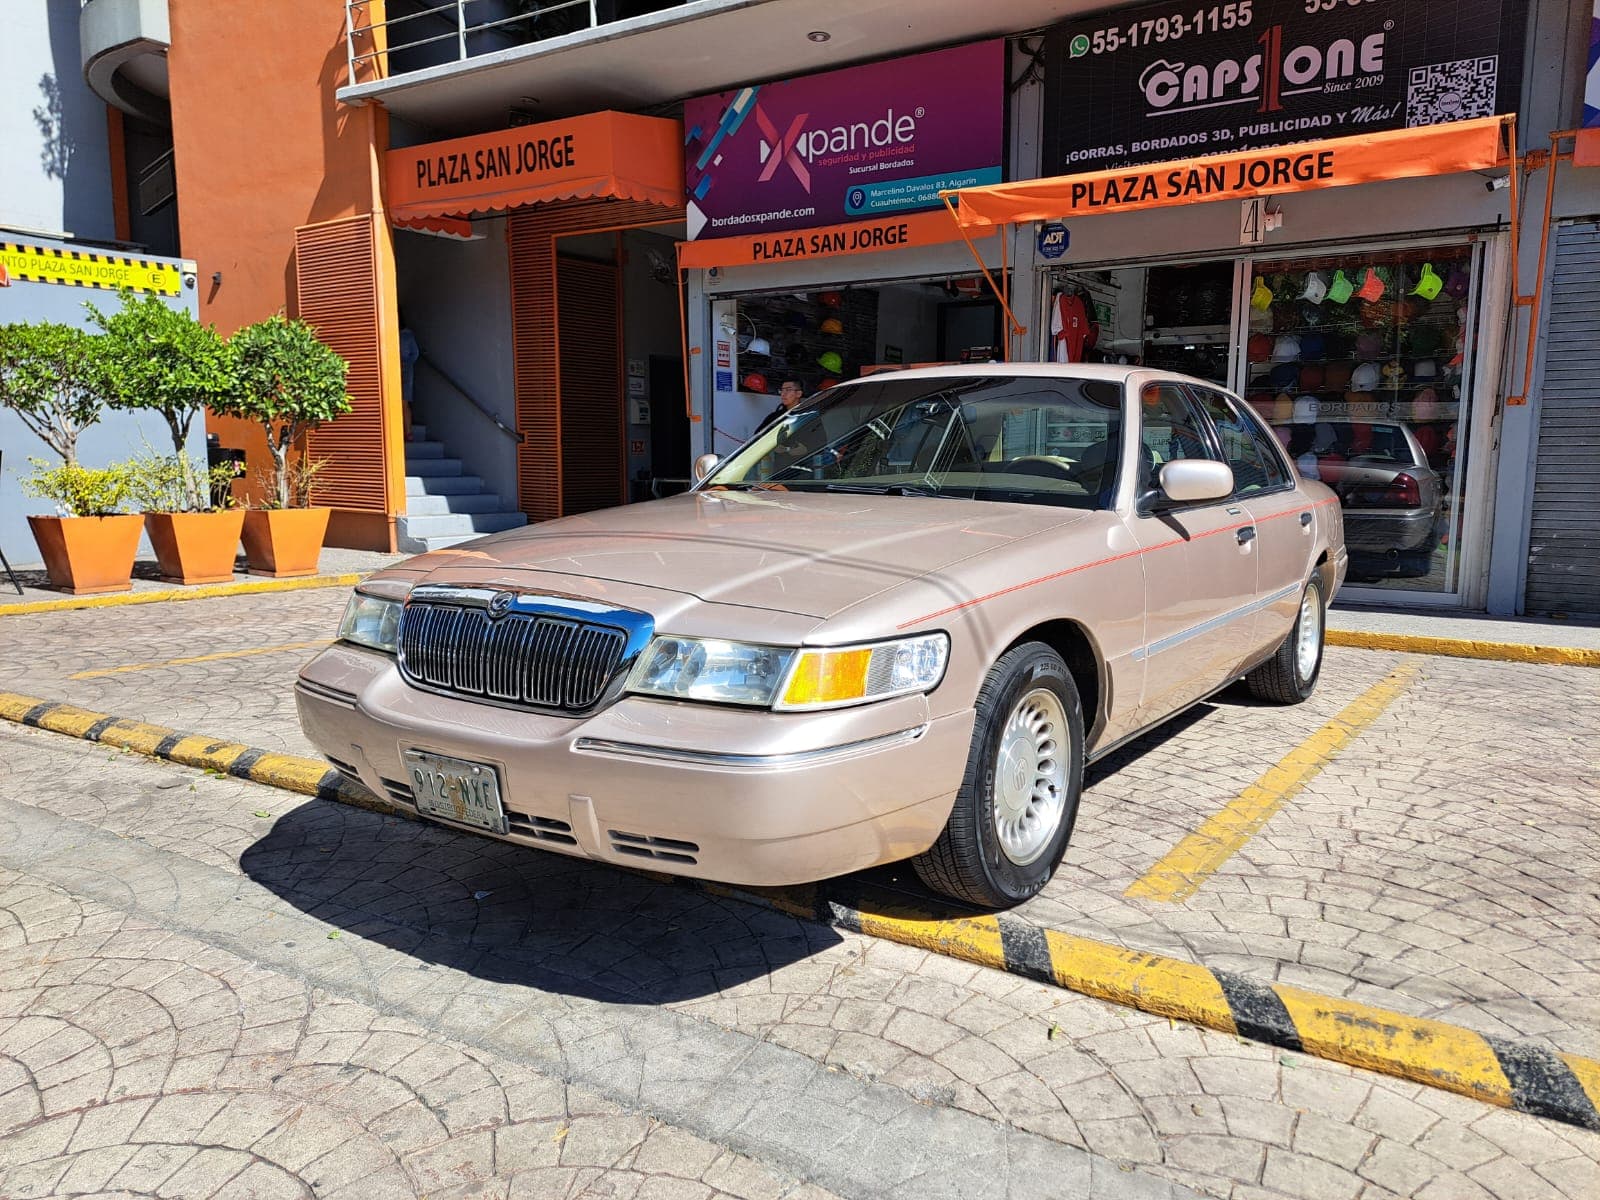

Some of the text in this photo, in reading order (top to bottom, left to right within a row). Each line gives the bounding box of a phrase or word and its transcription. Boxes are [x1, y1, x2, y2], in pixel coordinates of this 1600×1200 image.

[1092, 1, 1253, 54] 55-1793-1155
[1324, 74, 1384, 93] Since 2009
[1066, 144, 1127, 164] ¡GORRAS,
[1132, 132, 1207, 153] BORDADOS
[1212, 129, 1234, 142] 3D,
[1239, 115, 1332, 137] PUBLICIDAD
[1336, 112, 1347, 124] Y
[1351, 102, 1401, 123] Más!
[417, 135, 575, 188] PLAZA SAN JORGE
[818, 154, 859, 166] seguridad
[869, 144, 915, 159] publicidad
[849, 160, 914, 174] Sucursal Bordados
[1072, 175, 1158, 208] PLAZA
[1167, 165, 1225, 197] SAN
[1232, 151, 1334, 190] JORGE
[871, 187, 904, 197] Marcelino
[712, 207, 815, 227] bordadosxpande.com
[753, 224, 908, 260] PLAZA SAN JORGE
[1043, 231, 1065, 245] ADT
[31, 258, 67, 274] PLAZA
[70, 264, 92, 276] SAN
[95, 267, 129, 281] JORGE
[152, 274, 161, 284] E
[415, 768, 495, 811] 912-NXE
